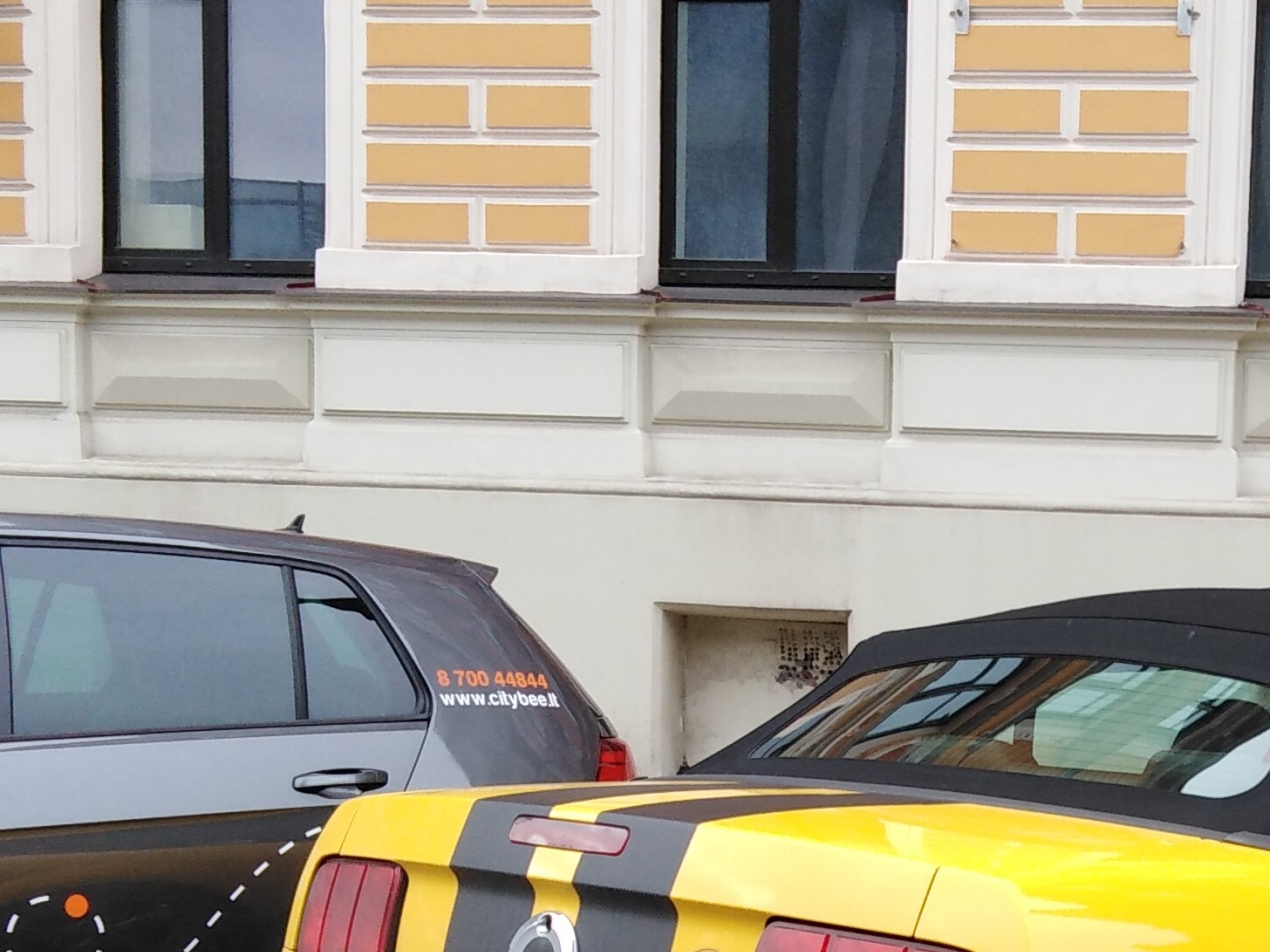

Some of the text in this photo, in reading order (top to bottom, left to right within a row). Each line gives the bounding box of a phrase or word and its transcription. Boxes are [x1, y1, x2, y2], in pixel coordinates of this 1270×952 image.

[437, 669, 549, 689] 8 700 44844
[439, 690, 560, 710] www.citybee.lt
